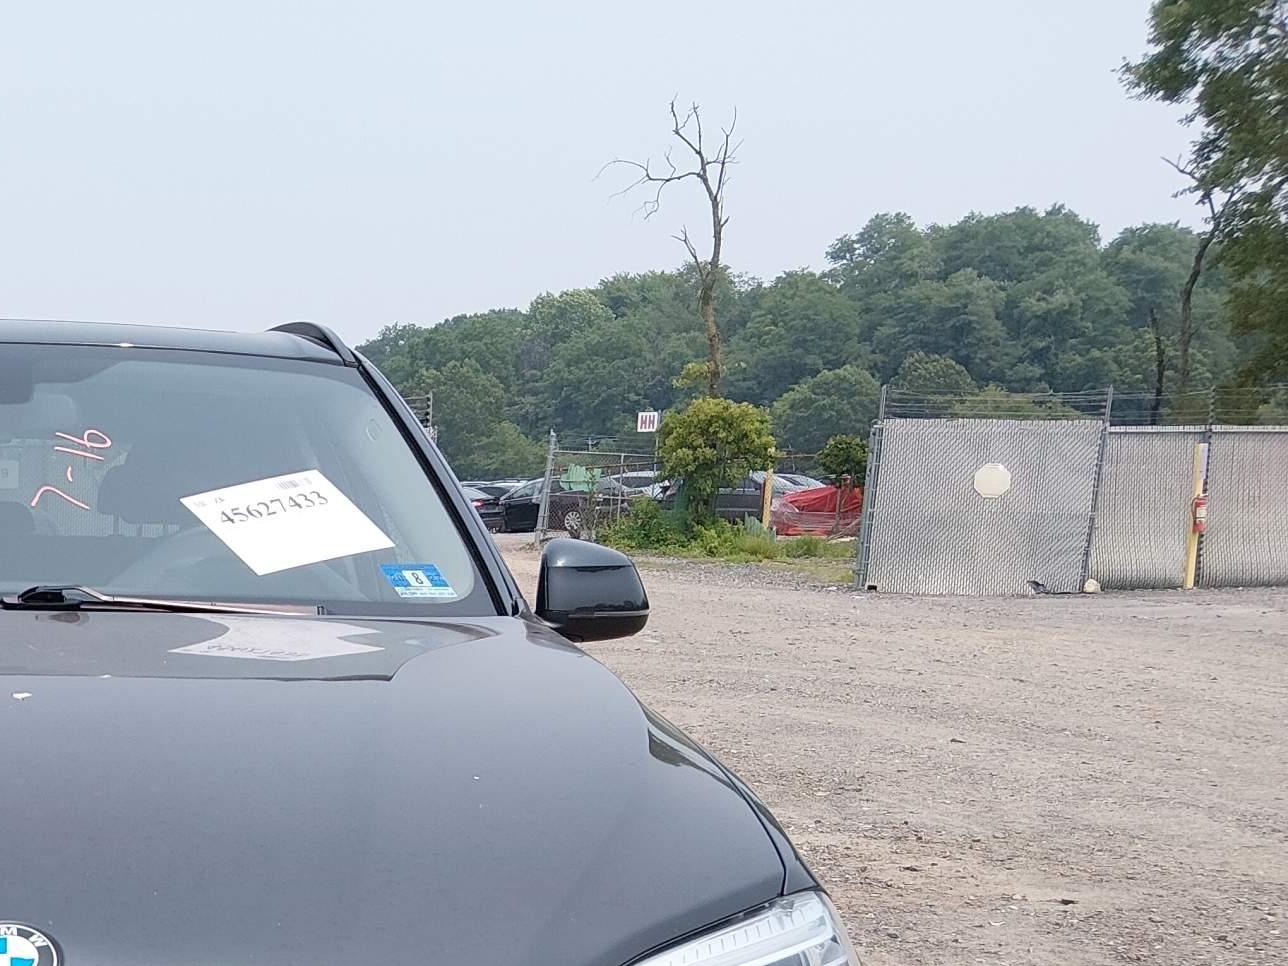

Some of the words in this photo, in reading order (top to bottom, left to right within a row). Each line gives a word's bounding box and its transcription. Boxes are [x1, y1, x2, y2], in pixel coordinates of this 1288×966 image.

[640, 414, 656, 429] HH
[30, 429, 112, 511] 7-16
[219, 490, 329, 525] 45627433
[411, 572, 424, 585] 8
